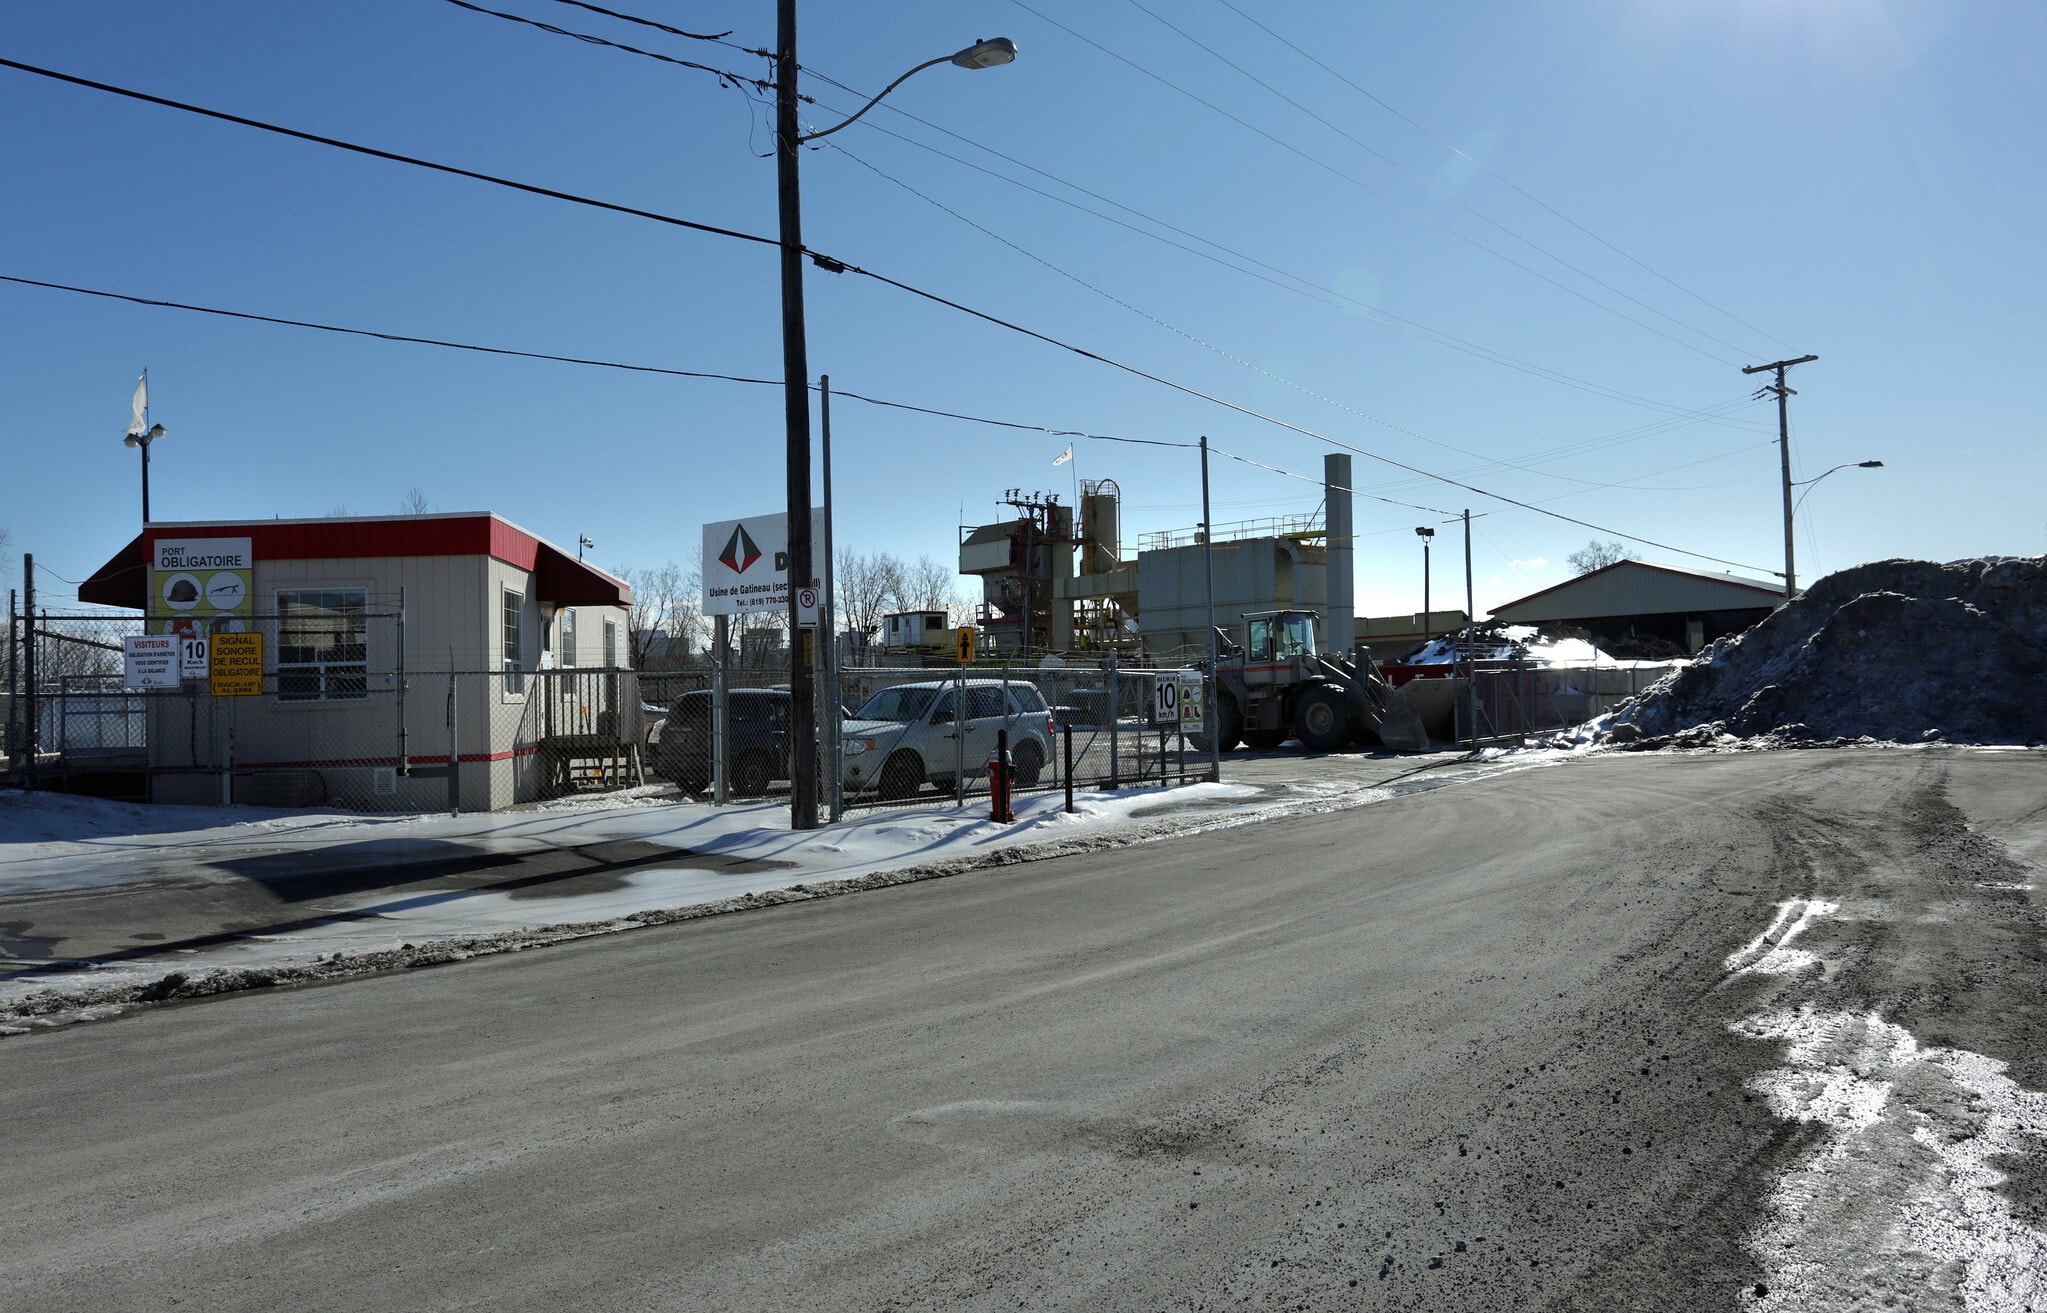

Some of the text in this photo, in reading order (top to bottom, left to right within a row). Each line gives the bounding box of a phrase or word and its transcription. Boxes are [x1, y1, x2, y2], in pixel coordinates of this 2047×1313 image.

[162, 547, 186, 556] PORT
[161, 555, 242, 568] OBLIGATOIRE
[709, 587, 728, 597] Usine
[730, 586, 739, 595] de
[740, 582, 771, 594] Gatineau
[750, 598, 764, 607] (819)
[766, 595, 789, 605] 770-230
[133, 640, 170, 649] VISITEURS
[219, 637, 255, 645] SIGNAL
[185, 641, 205, 659] 10
[216, 647, 257, 656] SONORE
[213, 657, 261, 666] DE RECUL
[213, 668, 261, 677] OBLIGATOIRE
[1157, 682, 1176, 709] 10
[1158, 710, 1175, 719] km/h
